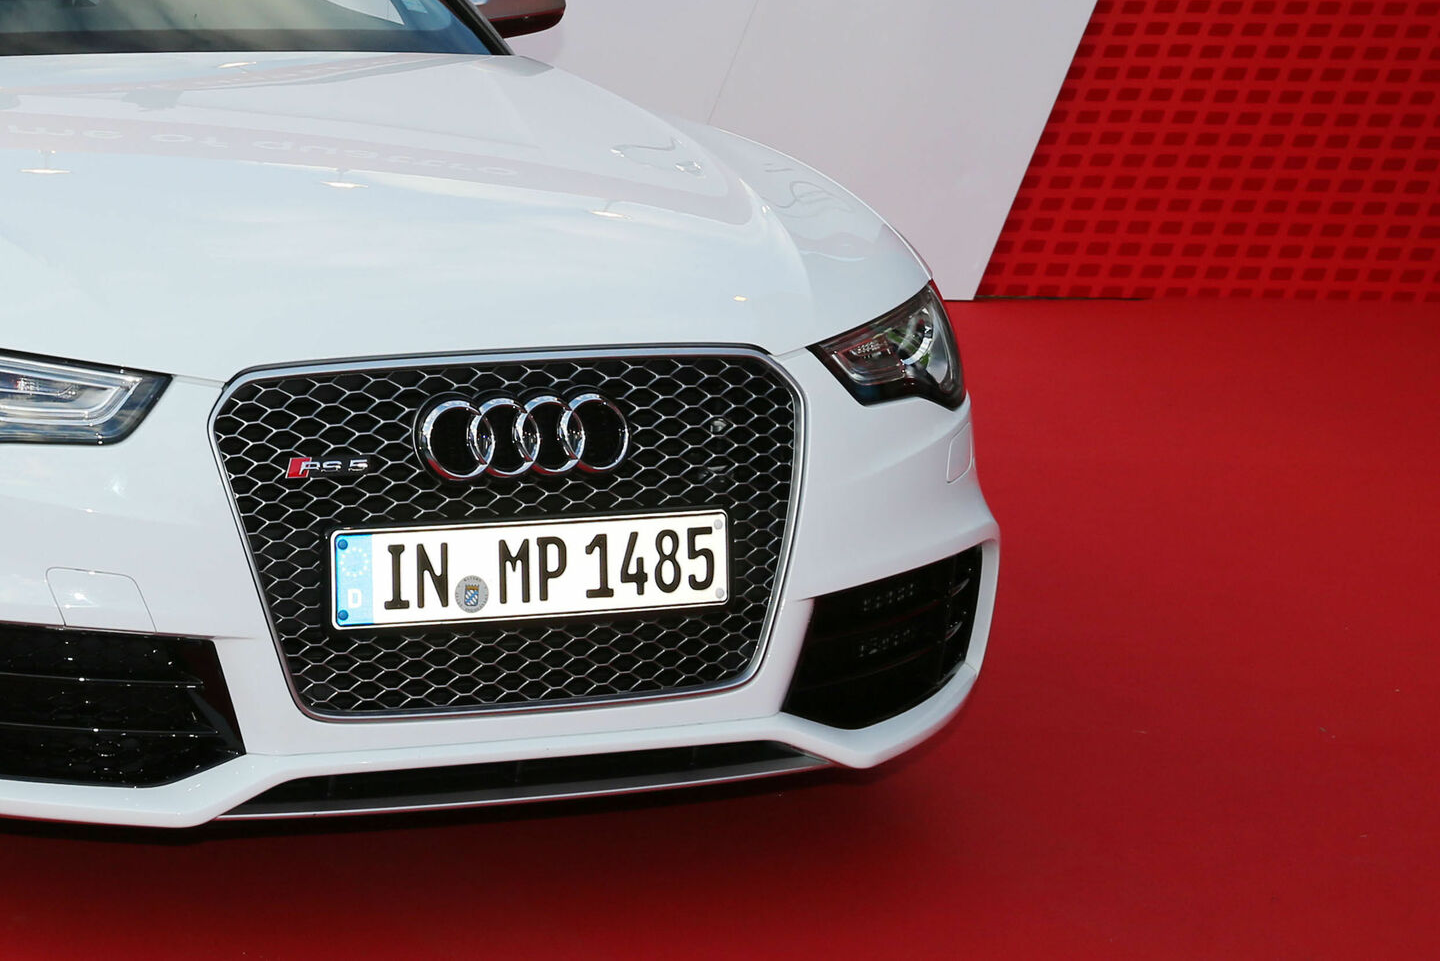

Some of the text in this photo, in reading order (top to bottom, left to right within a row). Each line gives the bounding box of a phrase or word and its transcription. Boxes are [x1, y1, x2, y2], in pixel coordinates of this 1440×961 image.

[384, 542, 449, 610] IN
[498, 536, 568, 605] MP
[585, 526, 715, 600] 1485
